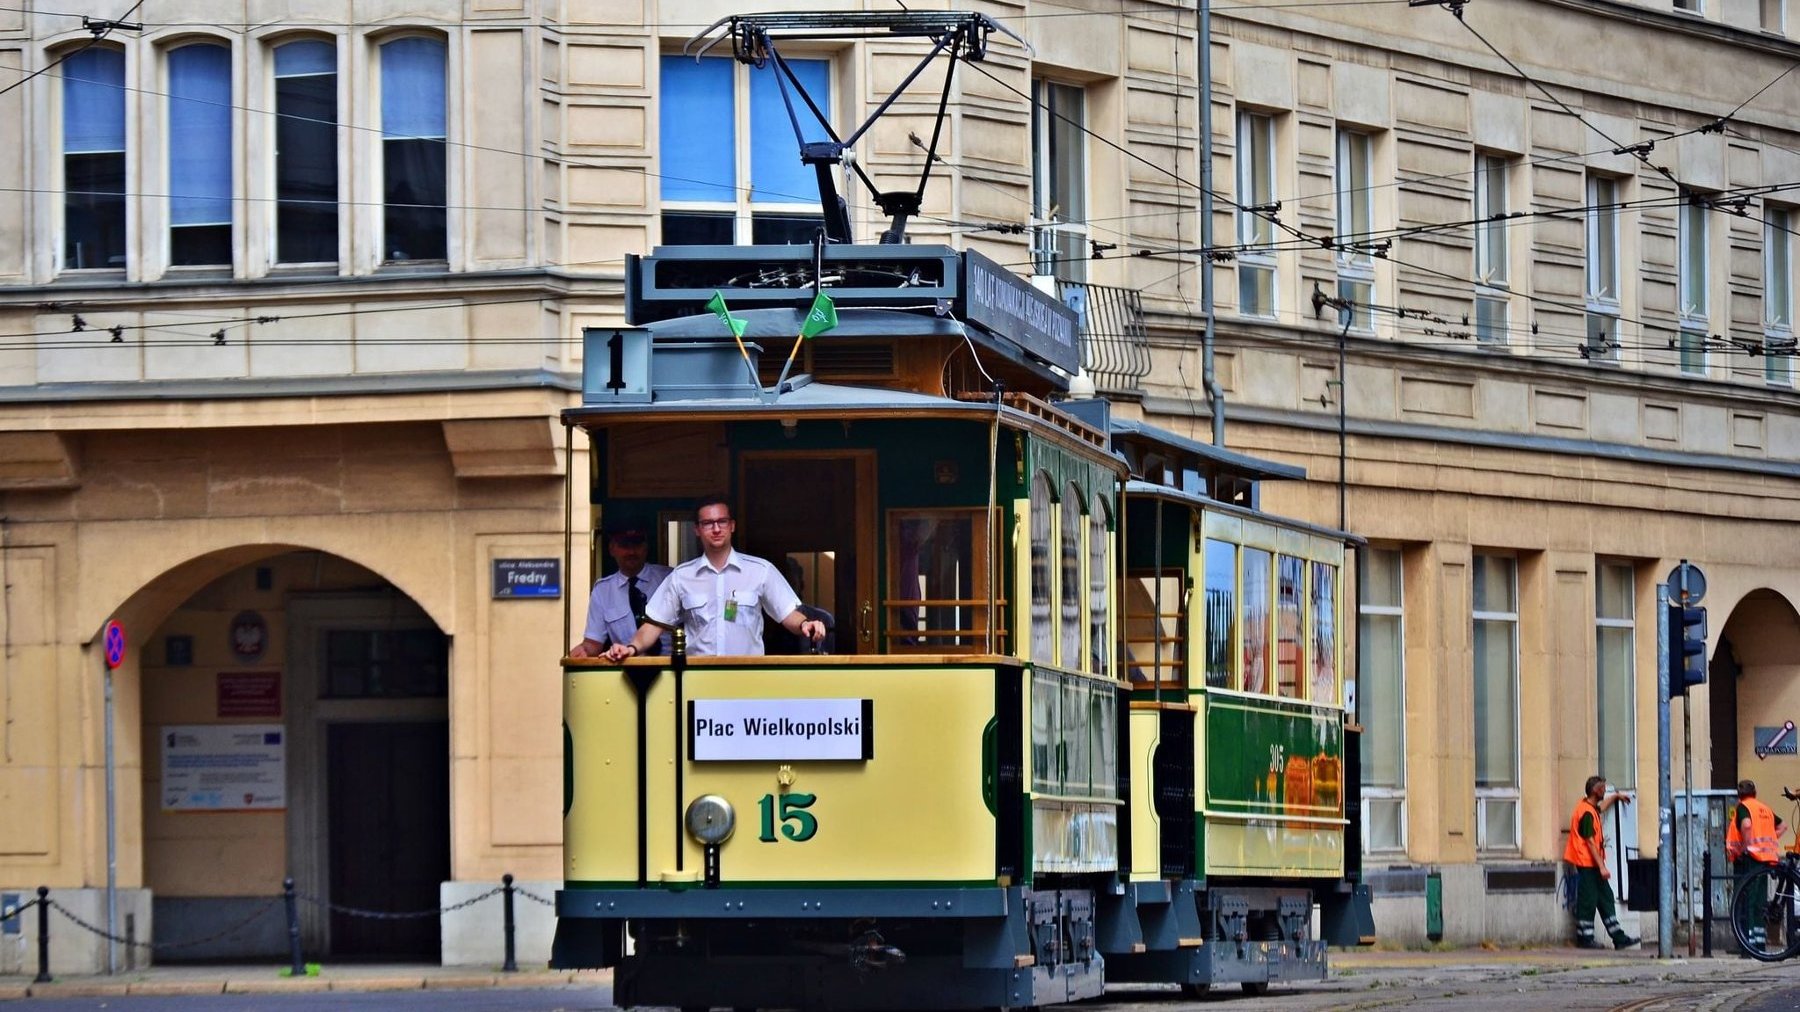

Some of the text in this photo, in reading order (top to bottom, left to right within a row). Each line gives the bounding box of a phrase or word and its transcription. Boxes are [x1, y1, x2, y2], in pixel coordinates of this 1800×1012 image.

[606, 334, 627, 389] 1
[507, 571, 547, 586] Fredry
[696, 717, 860, 740] Plac Wielkopolski
[1269, 743, 1284, 773] 305
[757, 793, 819, 843] 15
